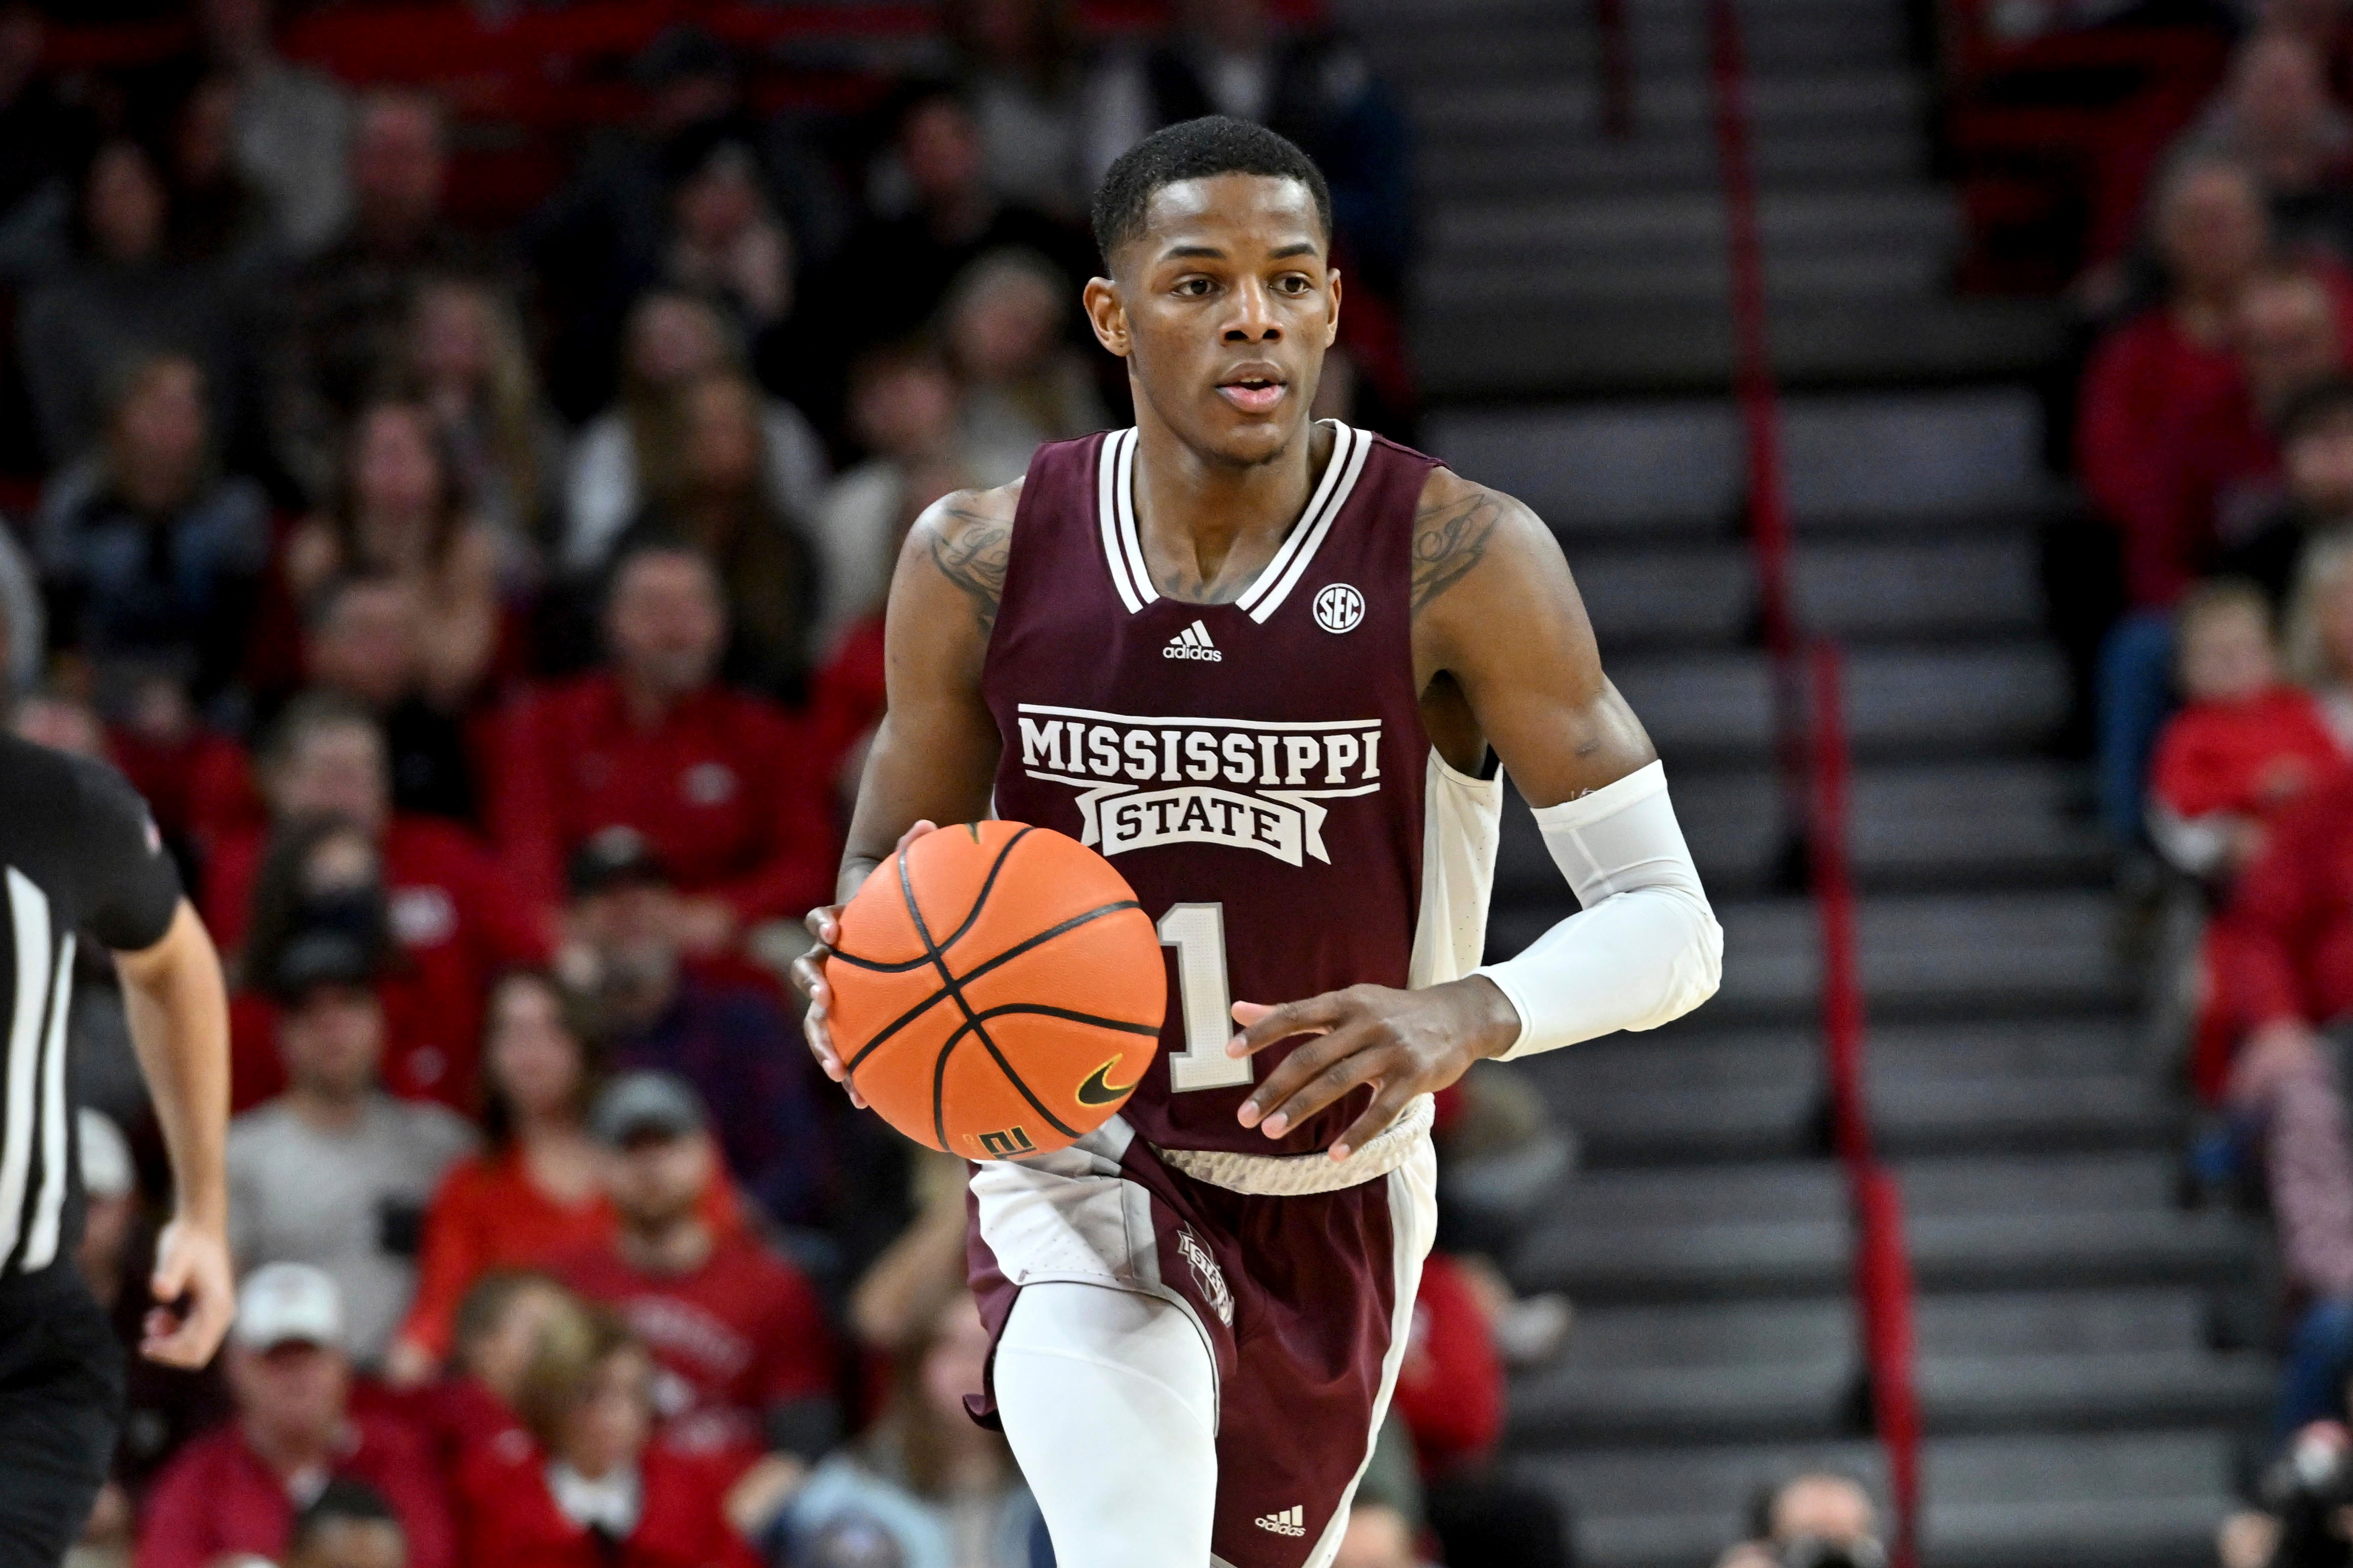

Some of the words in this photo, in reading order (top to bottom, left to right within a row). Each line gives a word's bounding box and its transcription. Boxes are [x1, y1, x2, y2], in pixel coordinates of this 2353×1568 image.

[1319, 588, 1360, 628] SEC
[1163, 645, 1222, 662] adidas
[1018, 717, 1382, 785] MISSISSIPPI
[1116, 796, 1282, 847] STATE
[1157, 902, 1255, 1093] 1
[1255, 1517, 1306, 1537] adidas
